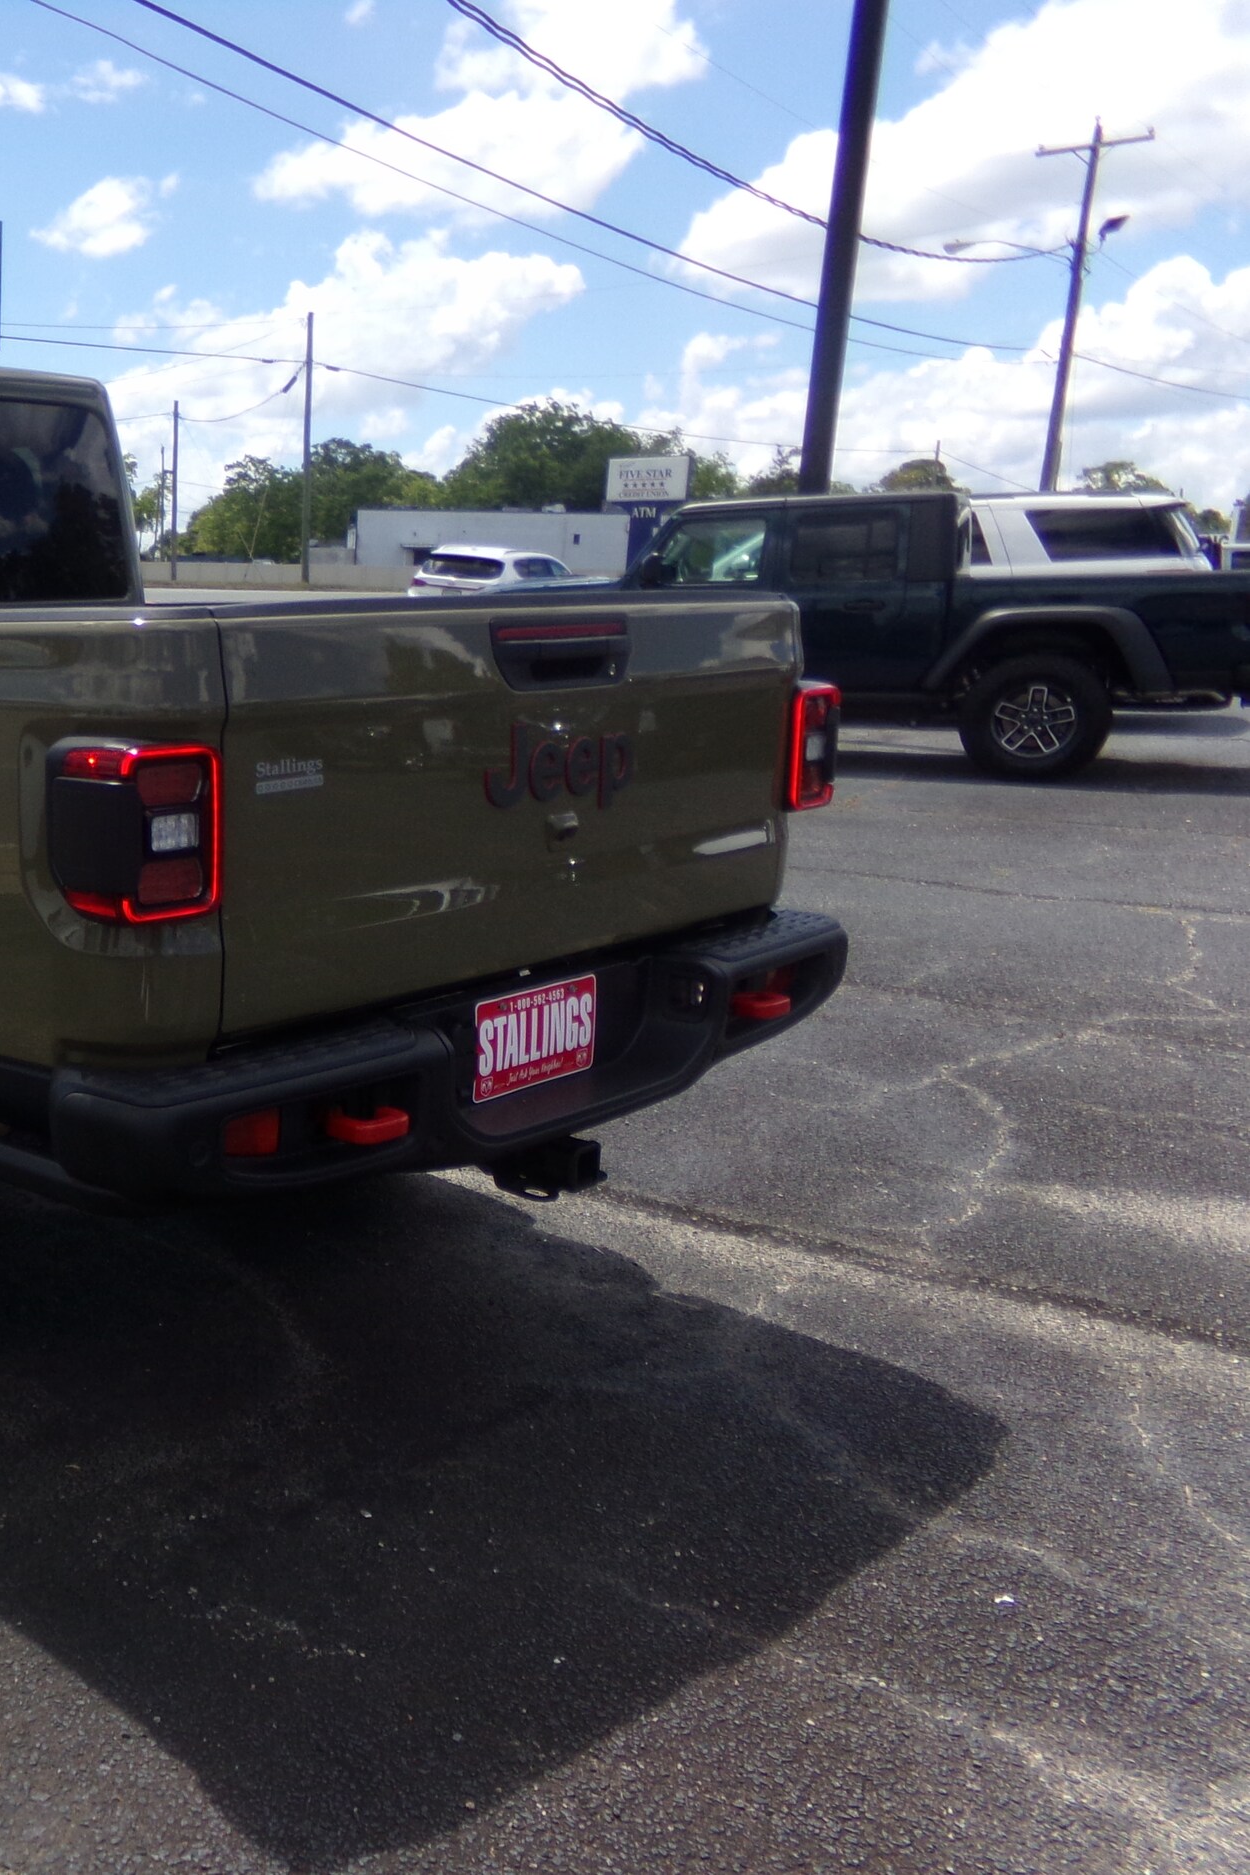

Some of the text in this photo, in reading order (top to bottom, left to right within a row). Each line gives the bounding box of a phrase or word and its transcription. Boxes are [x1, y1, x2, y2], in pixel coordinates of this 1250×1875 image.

[619, 468, 672, 479] FIVE STAR
[632, 507, 657, 518] ATM
[256, 758, 324, 778] Stallings
[484, 721, 635, 809] Jeep
[478, 993, 593, 1077] STALLINGS
